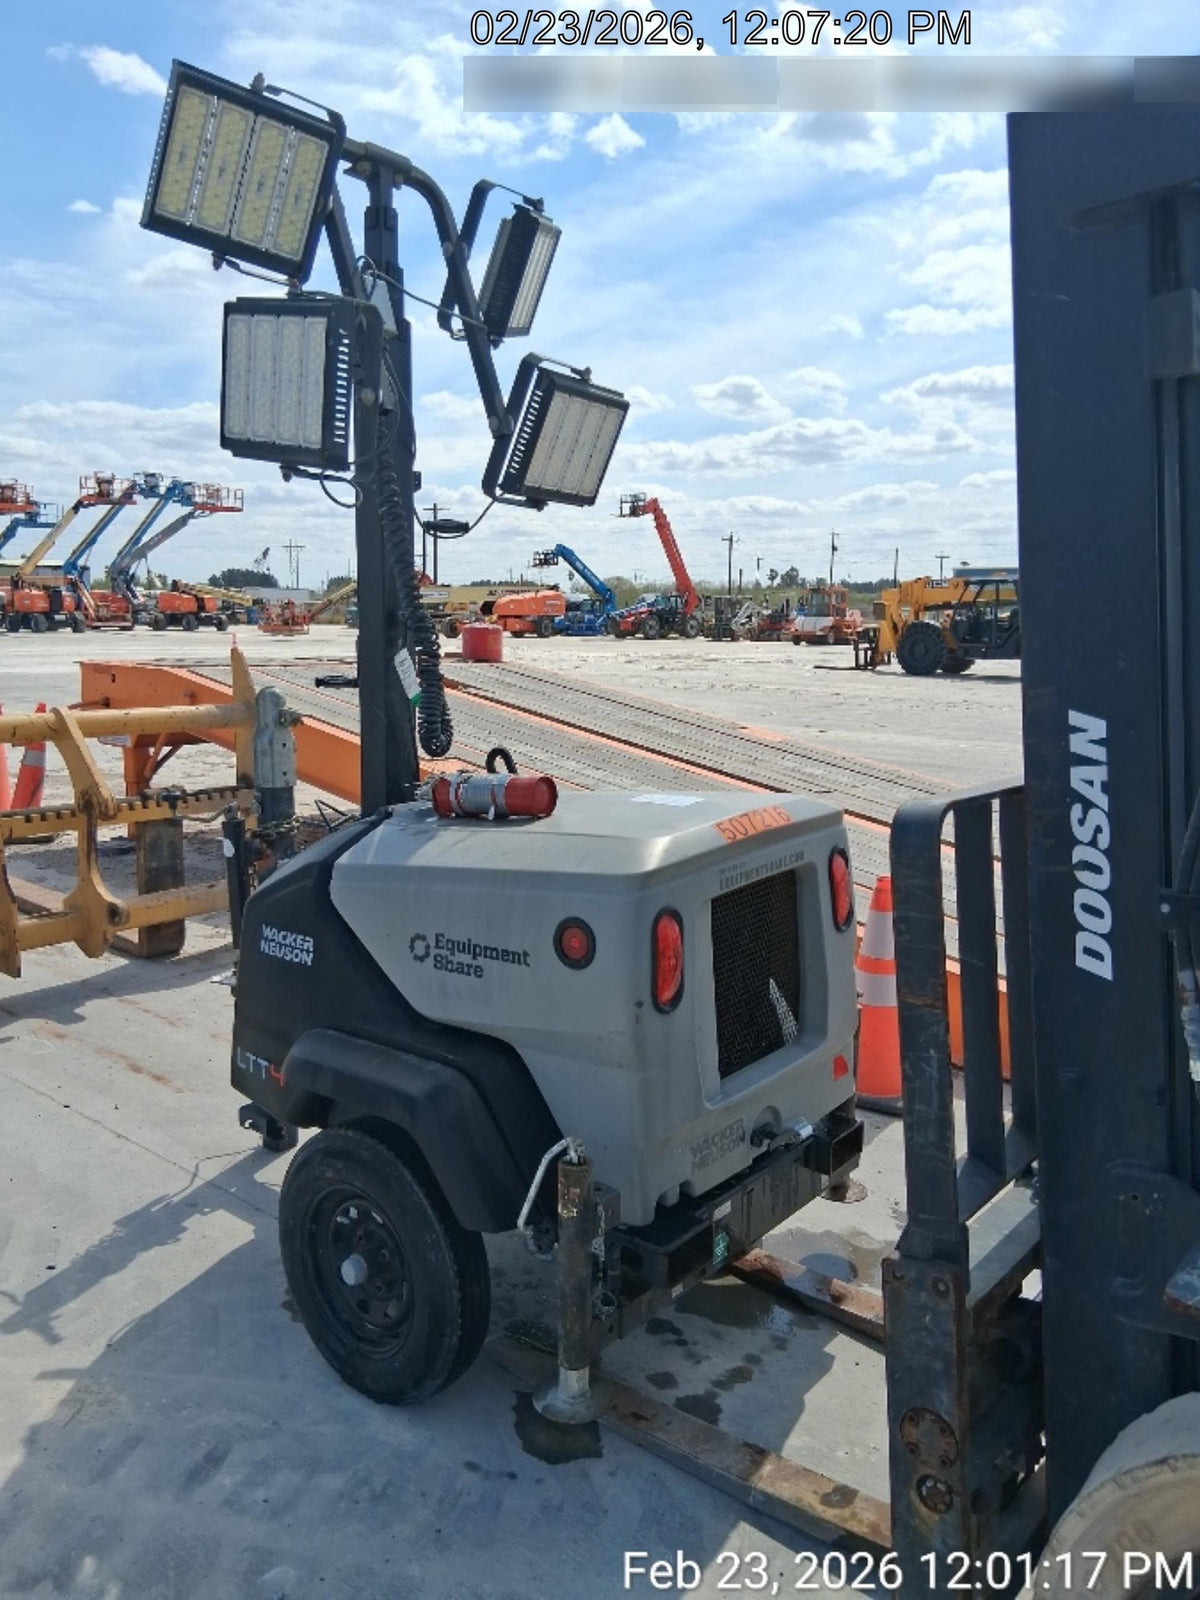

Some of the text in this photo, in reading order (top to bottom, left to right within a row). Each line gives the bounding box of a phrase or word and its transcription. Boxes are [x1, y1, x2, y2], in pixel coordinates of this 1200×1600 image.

[1068, 709, 1113, 981] DOOSAN
[260, 939, 314, 966] NEUSON
[262, 924, 314, 952] WACKER
[434, 932, 531, 967] Equipment
[433, 953, 484, 979] Share
[237, 1047, 285, 1087] LTT4
